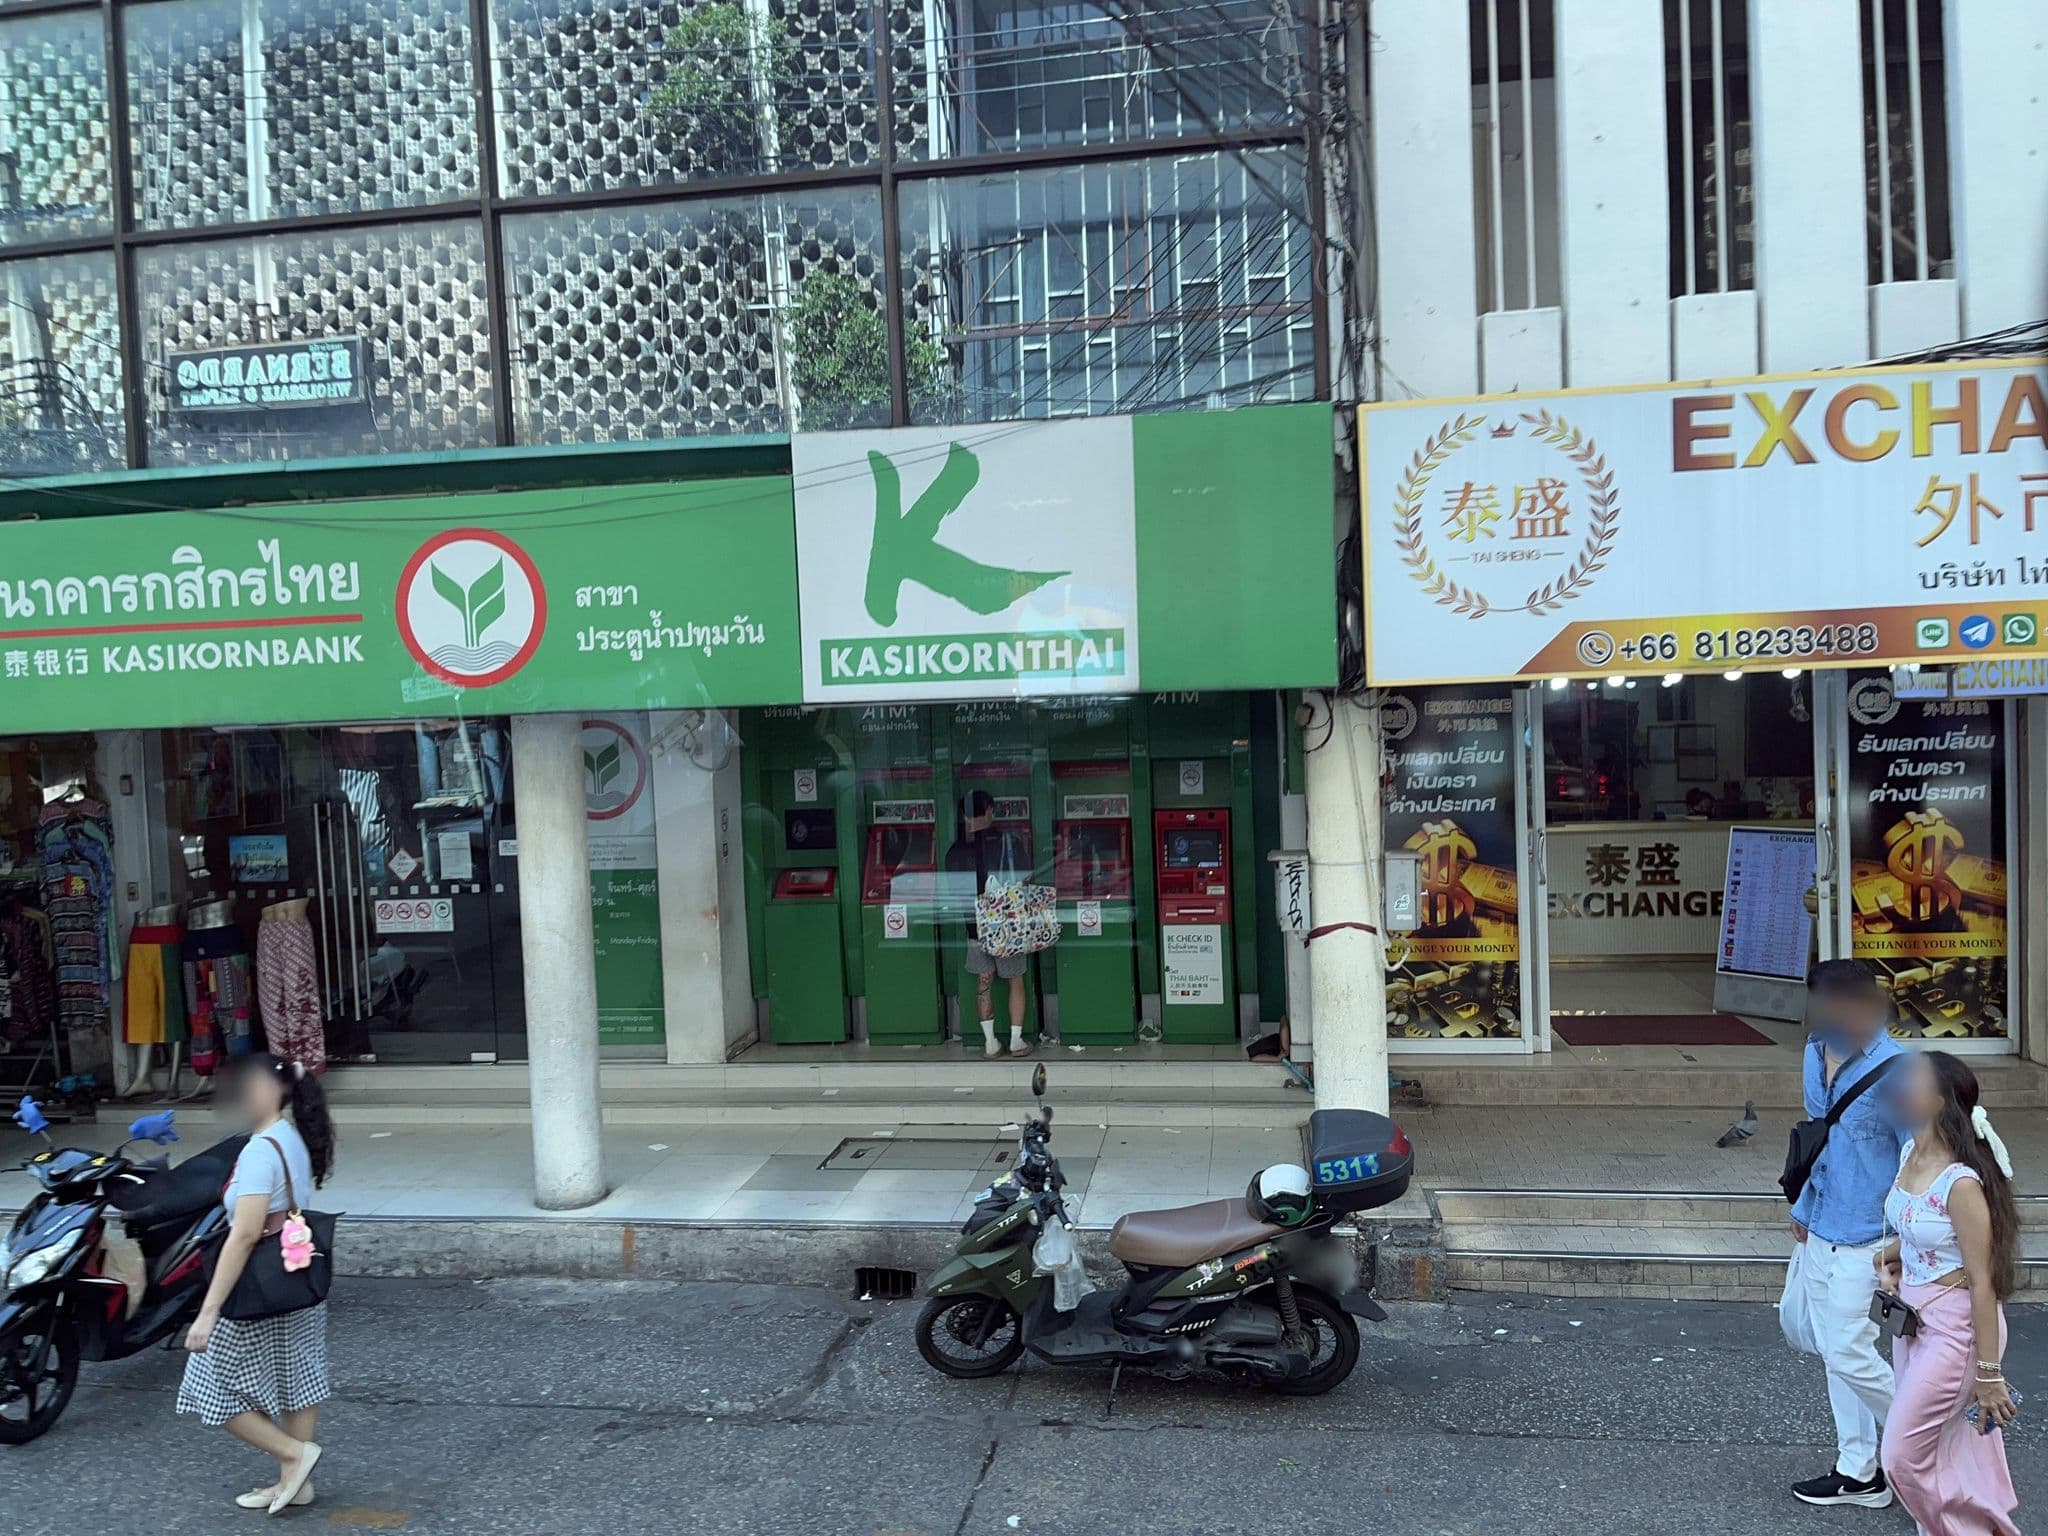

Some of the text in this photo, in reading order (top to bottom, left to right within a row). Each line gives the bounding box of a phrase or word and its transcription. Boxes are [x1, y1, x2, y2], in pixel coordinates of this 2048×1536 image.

[1441, 477, 1570, 543] 泰盛
[863, 441, 1073, 627] K
[1471, 551, 1492, 563] TAI
[0, 538, 360, 619] นาคารกสิกรไทย
[1919, 560, 2006, 589] บริษัท
[575, 584, 638, 608] สาขา
[577, 610, 765, 661] ประตูน้ำปทุมวัน
[1620, 623, 1877, 662] +66 818233488
[4, 647, 89, 678] 泰银行
[103, 634, 364, 673] KASIKORNBANK
[830, 637, 1115, 678] KASIKORNTHAI
[1857, 725, 1996, 753] รับแลกเปลี่ยน
[1406, 773, 1477, 790] เงินตรา
[1887, 758, 1966, 777] เงินตรา
[1389, 795, 1497, 814] ต่างประเทศ
[1868, 783, 1987, 803] ต่างประเทศ
[1585, 842, 1681, 887] 泰盛
[1176, 934, 1202, 943] CHECK
[1204, 934, 1213, 943] ID
[1440, 945, 1470, 953] YOUR
[1474, 944, 1515, 953] MONEY
[1853, 938, 2004, 950] EXCHANGE YOUR MONEY
